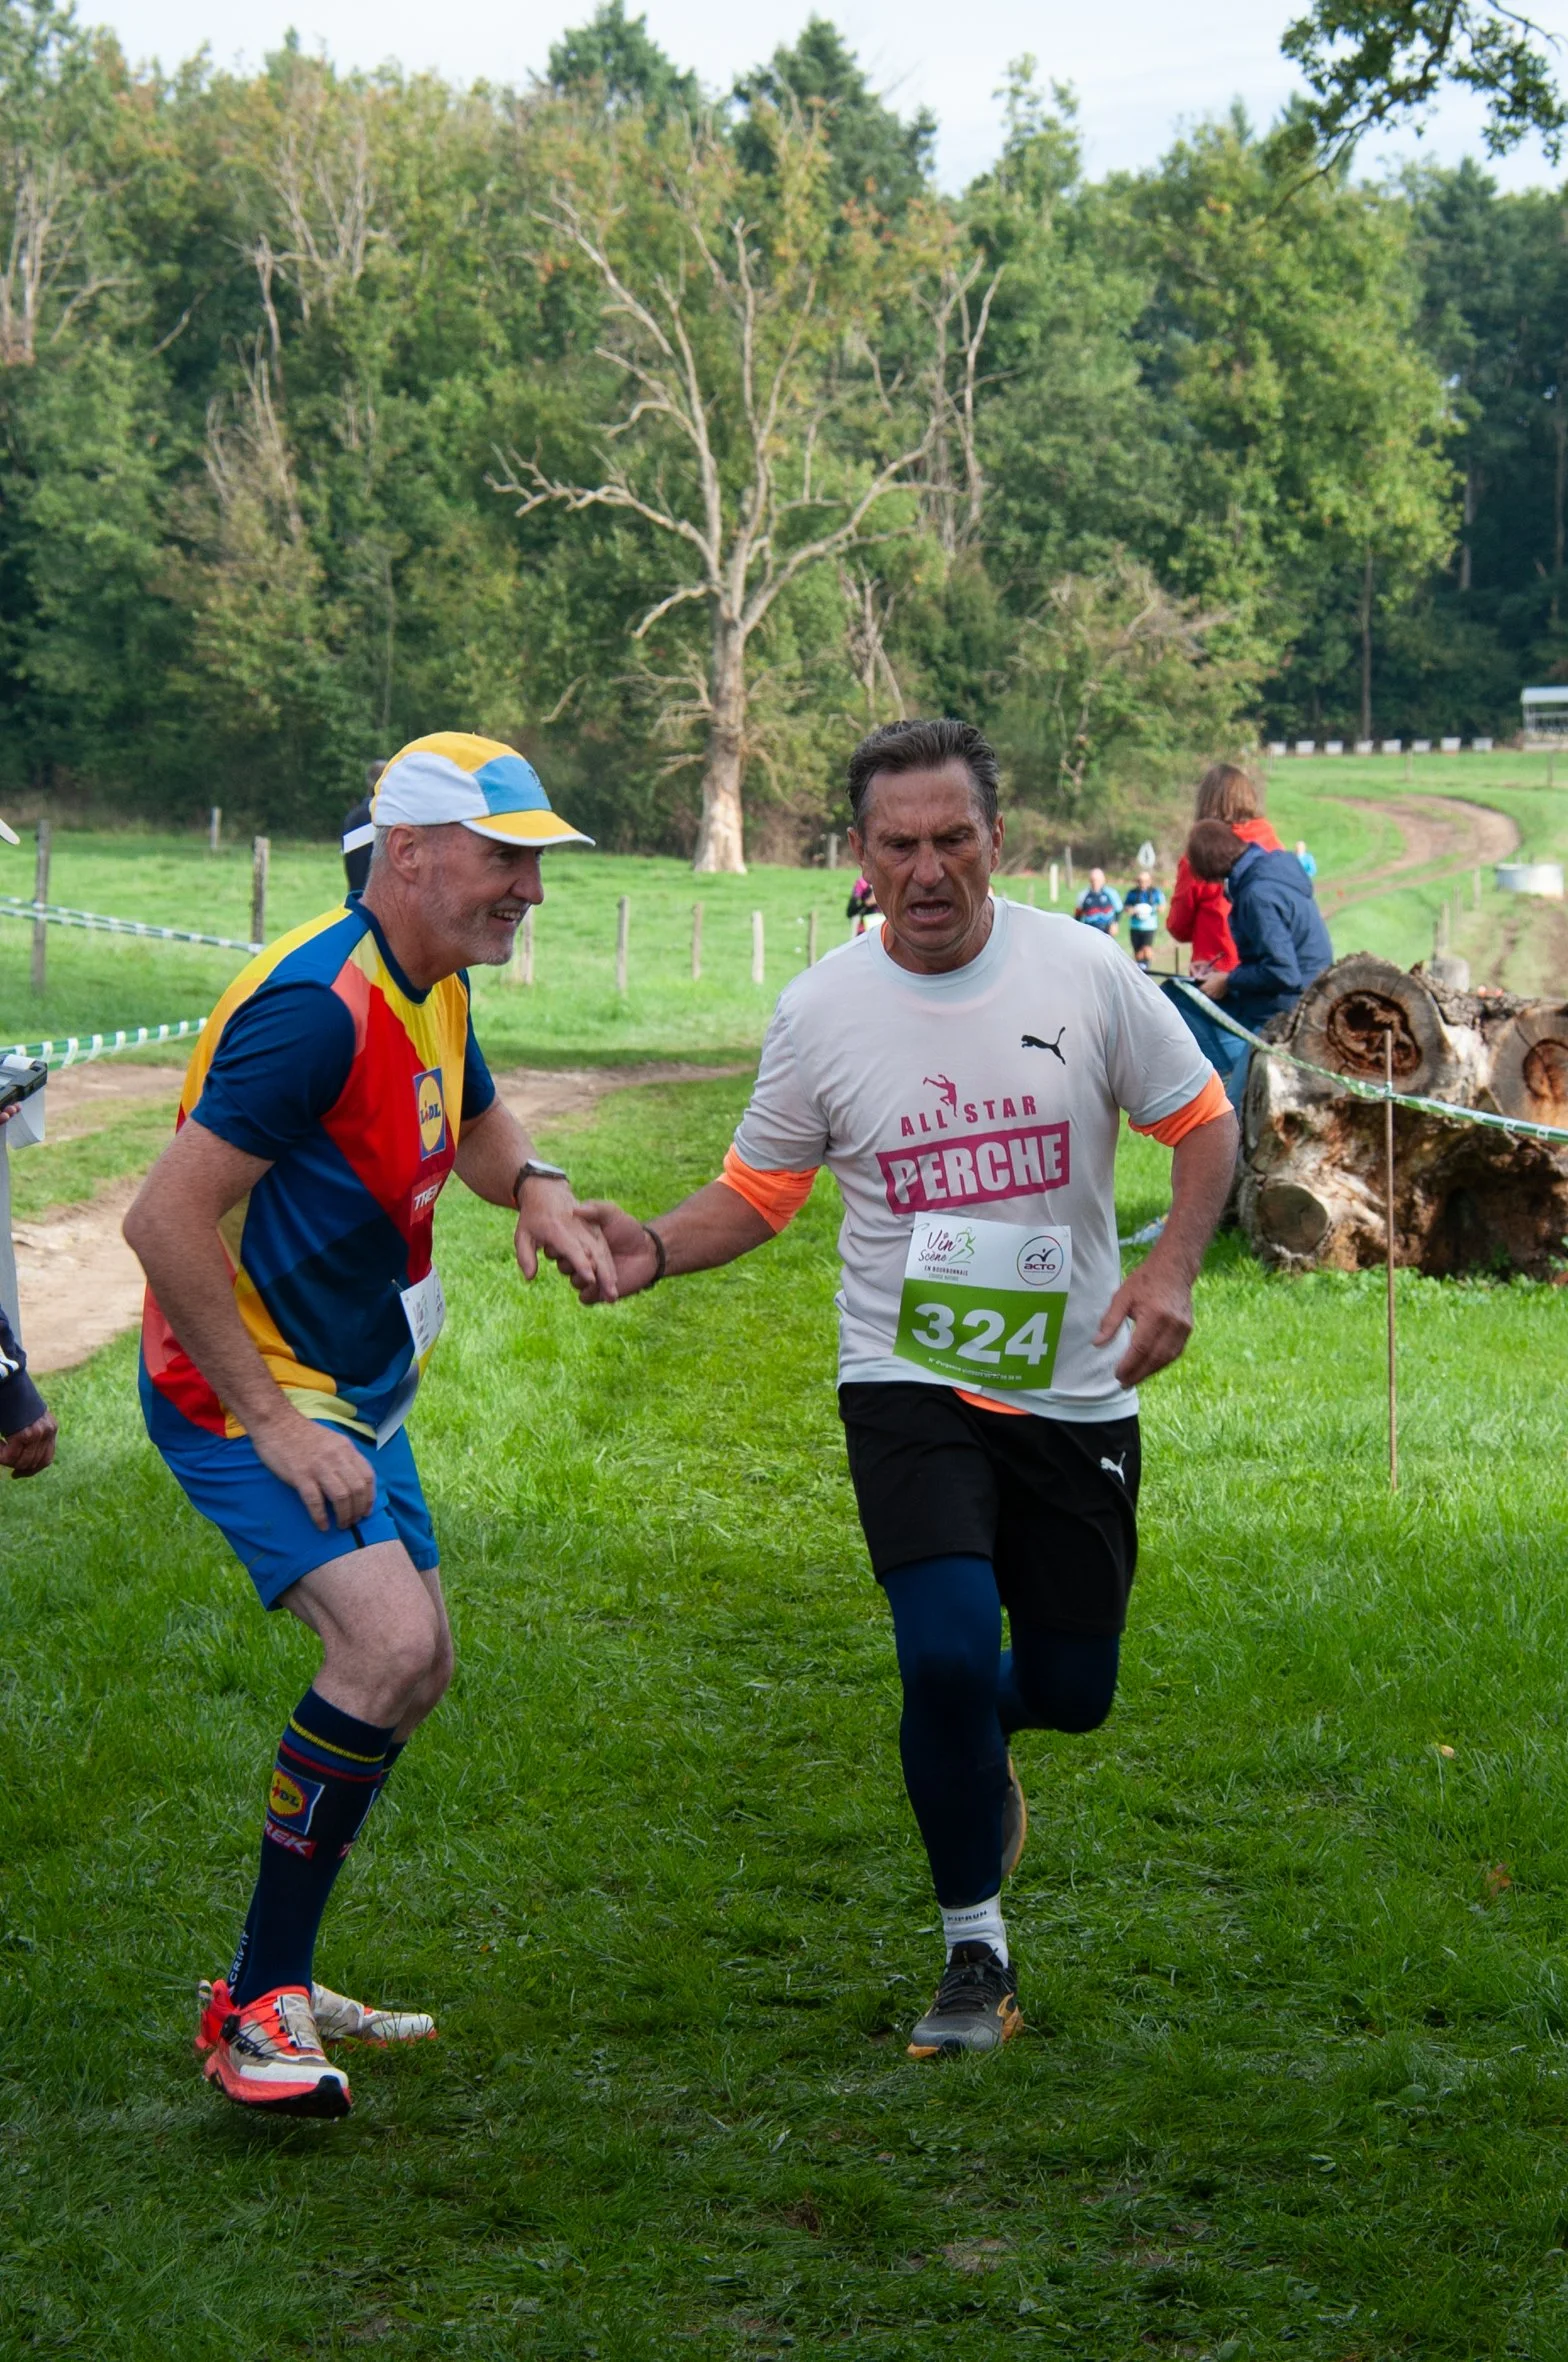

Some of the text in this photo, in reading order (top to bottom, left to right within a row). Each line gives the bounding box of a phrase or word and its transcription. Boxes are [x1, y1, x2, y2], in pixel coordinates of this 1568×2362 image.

[901, 1095, 1037, 1137] ALL STAR
[888, 1133, 1062, 1204] PERCHE
[918, 1248, 947, 1262] Scène
[927, 1228, 956, 1251] Vin
[911, 1303, 1048, 1365] 324
